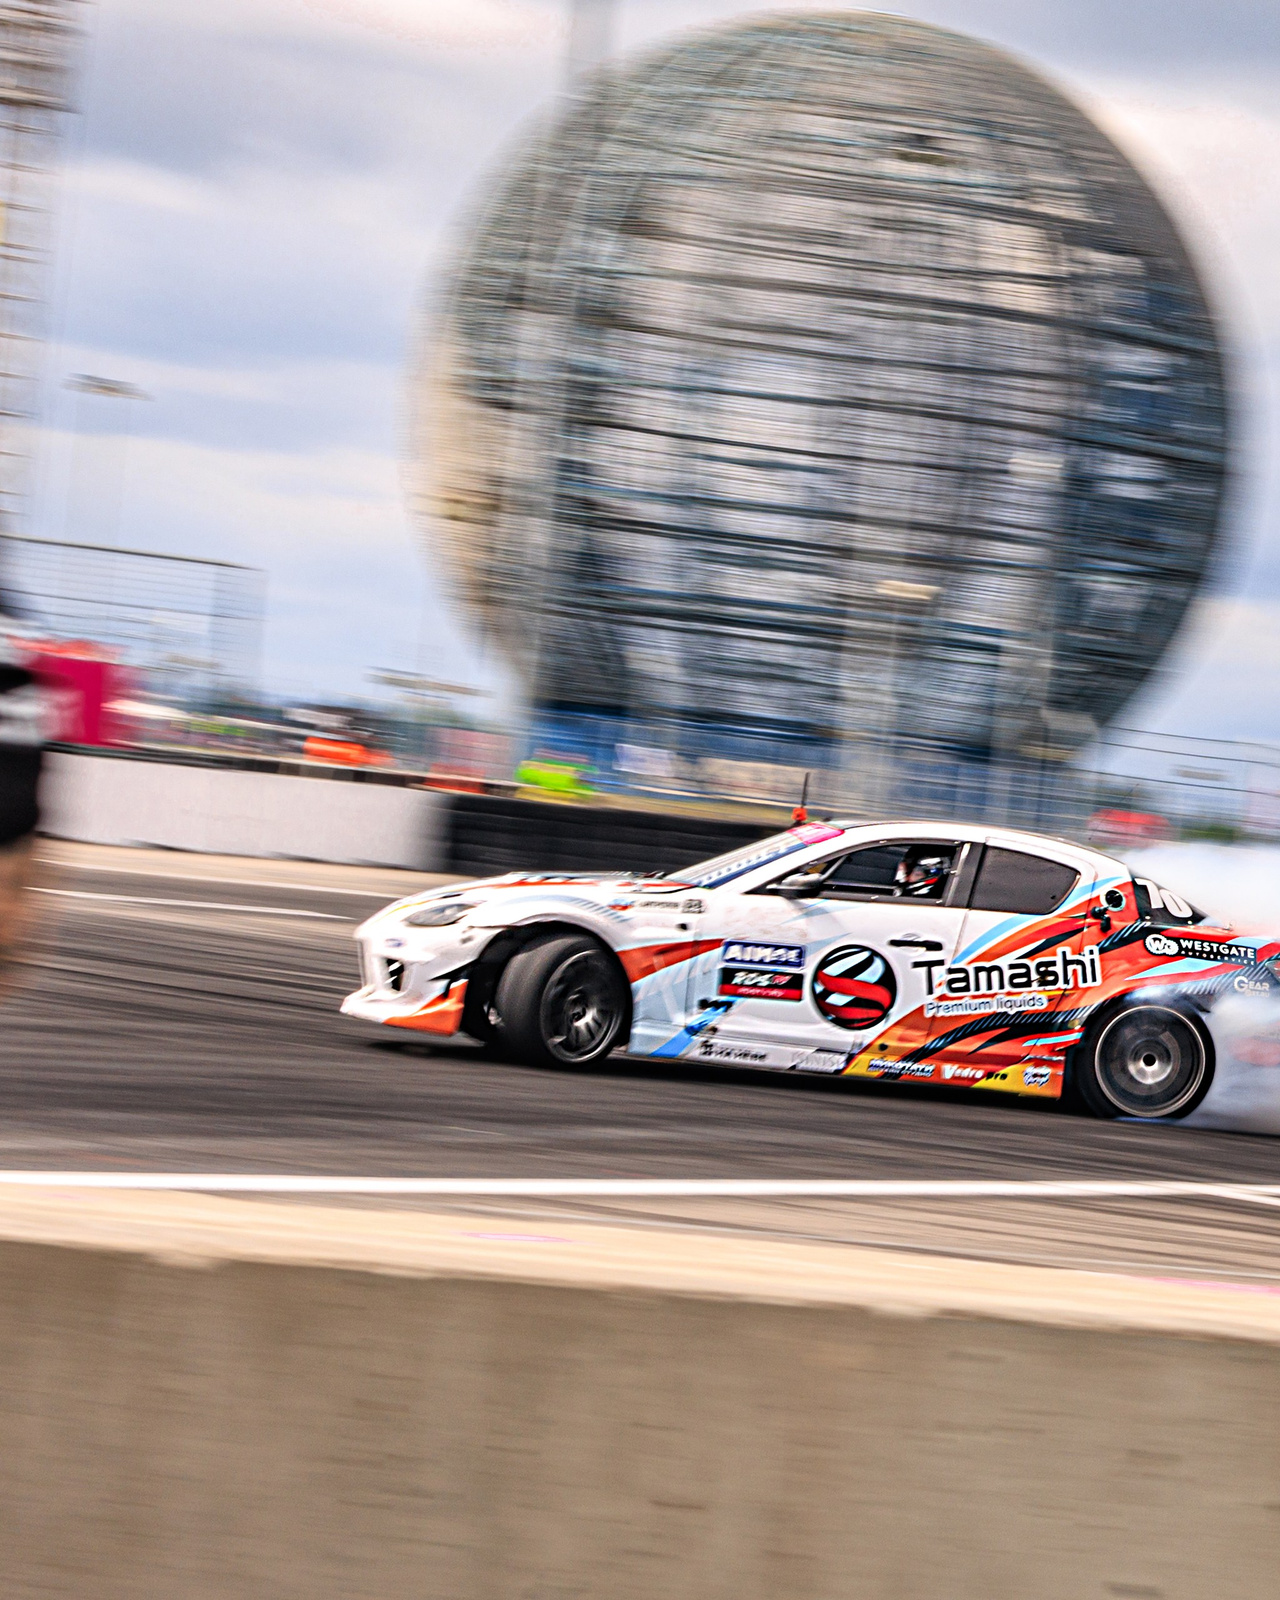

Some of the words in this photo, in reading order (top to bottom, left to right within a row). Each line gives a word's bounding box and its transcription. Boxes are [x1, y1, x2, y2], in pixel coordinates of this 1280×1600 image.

[1180, 939, 1255, 959] WESTGATE
[912, 949, 1098, 996] Tamashi
[1234, 975, 1270, 992] GEAR
[926, 999, 991, 1015] Premium
[996, 996, 1044, 1013] liquids
